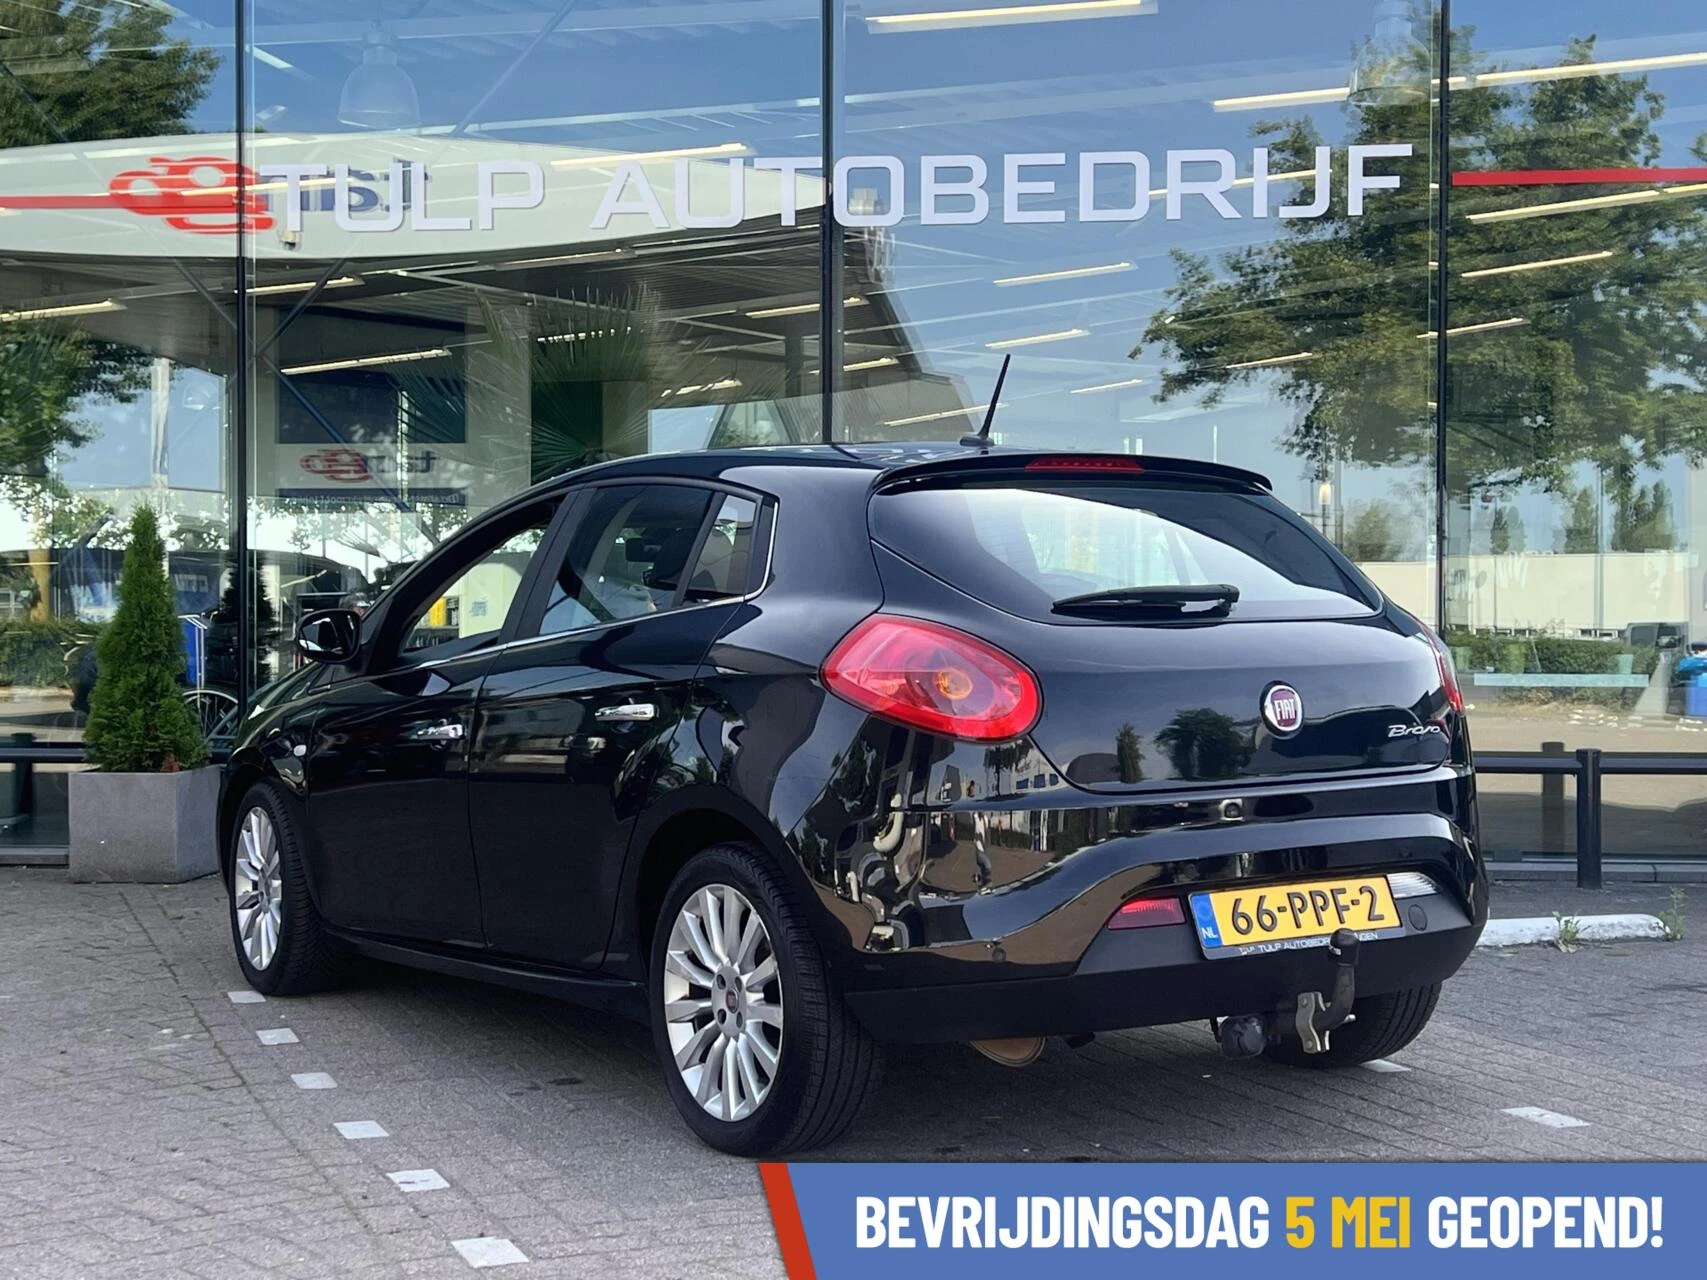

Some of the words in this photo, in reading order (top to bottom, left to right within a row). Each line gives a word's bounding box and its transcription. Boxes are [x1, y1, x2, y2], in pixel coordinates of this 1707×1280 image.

[260, 160, 546, 232] TULP
[590, 143, 1413, 230] AUTOBEDRIJF
[1273, 699, 1296, 721] FIAT
[1387, 724, 1441, 738] Bravo
[1230, 885, 1385, 935] 66-PPF-2
[1201, 926, 1219, 940] NL
[1257, 942, 1282, 952] TULP
[1283, 936, 1331, 950] AUTOBEDR
